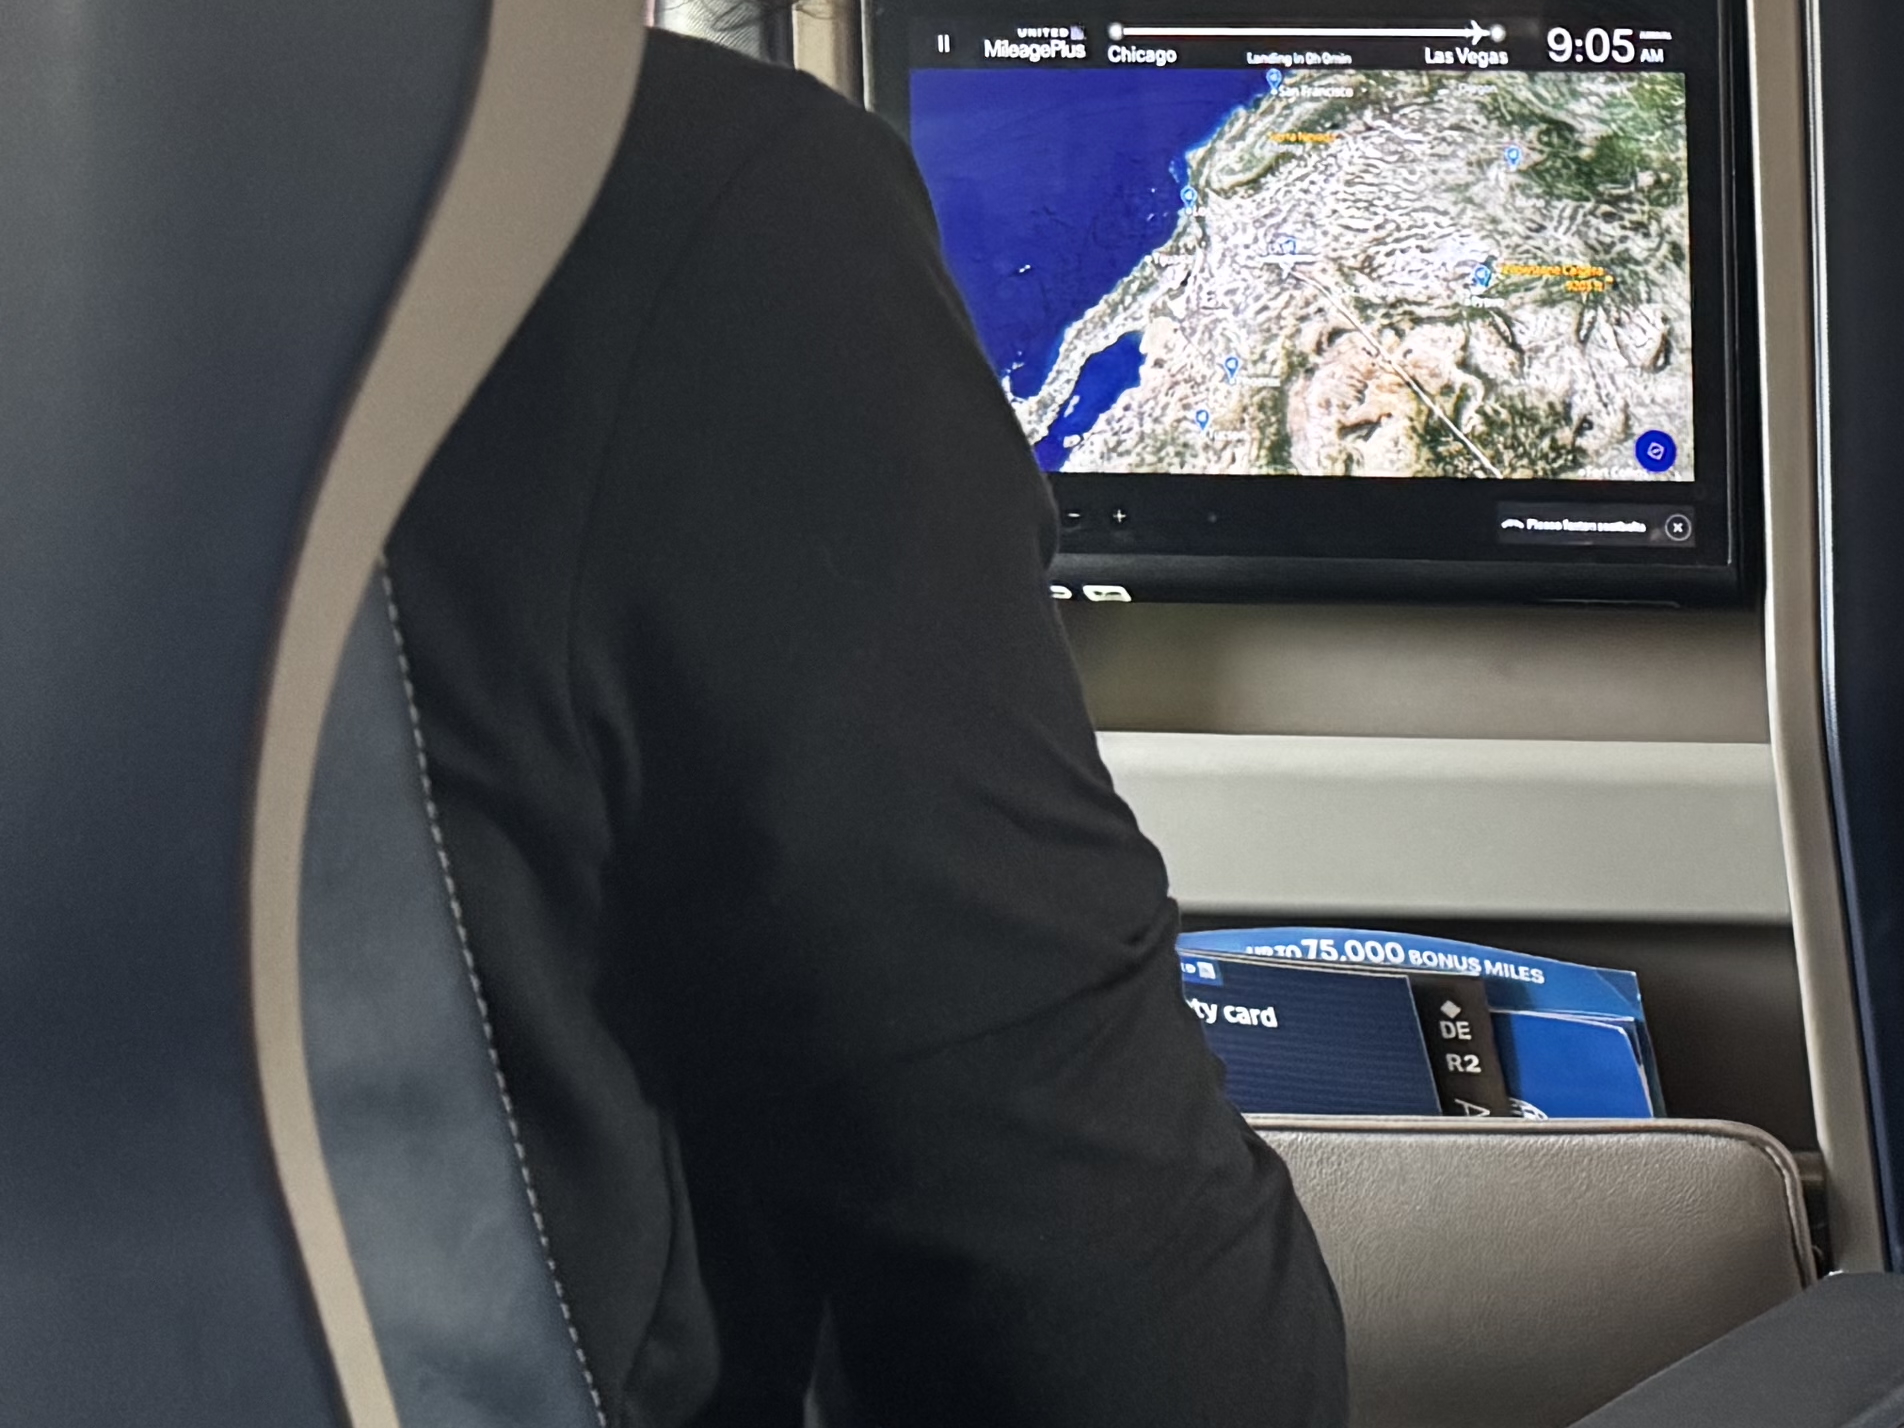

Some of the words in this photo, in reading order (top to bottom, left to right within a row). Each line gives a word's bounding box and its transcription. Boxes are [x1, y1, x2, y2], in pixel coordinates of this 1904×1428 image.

[1017, 27, 1070, 38] UNITED
[984, 39, 1086, 62] MileagePlus
[1547, 27, 1635, 63] 9:05
[1107, 45, 1177, 66] Chicago
[1247, 52, 1291, 66] Landing
[1425, 48, 1456, 64] Las
[1458, 48, 1508, 67] Vegas
[1640, 49, 1664, 63] AM
[1278, 85, 1298, 97] San
[1300, 85, 1353, 97] Francisco
[1408, 950, 1482, 975] BONUS
[1483, 959, 1546, 984] MILES
[1223, 1005, 1278, 1028] card
[1439, 1020, 1472, 1041] DE
[1445, 1053, 1482, 1073] R2
